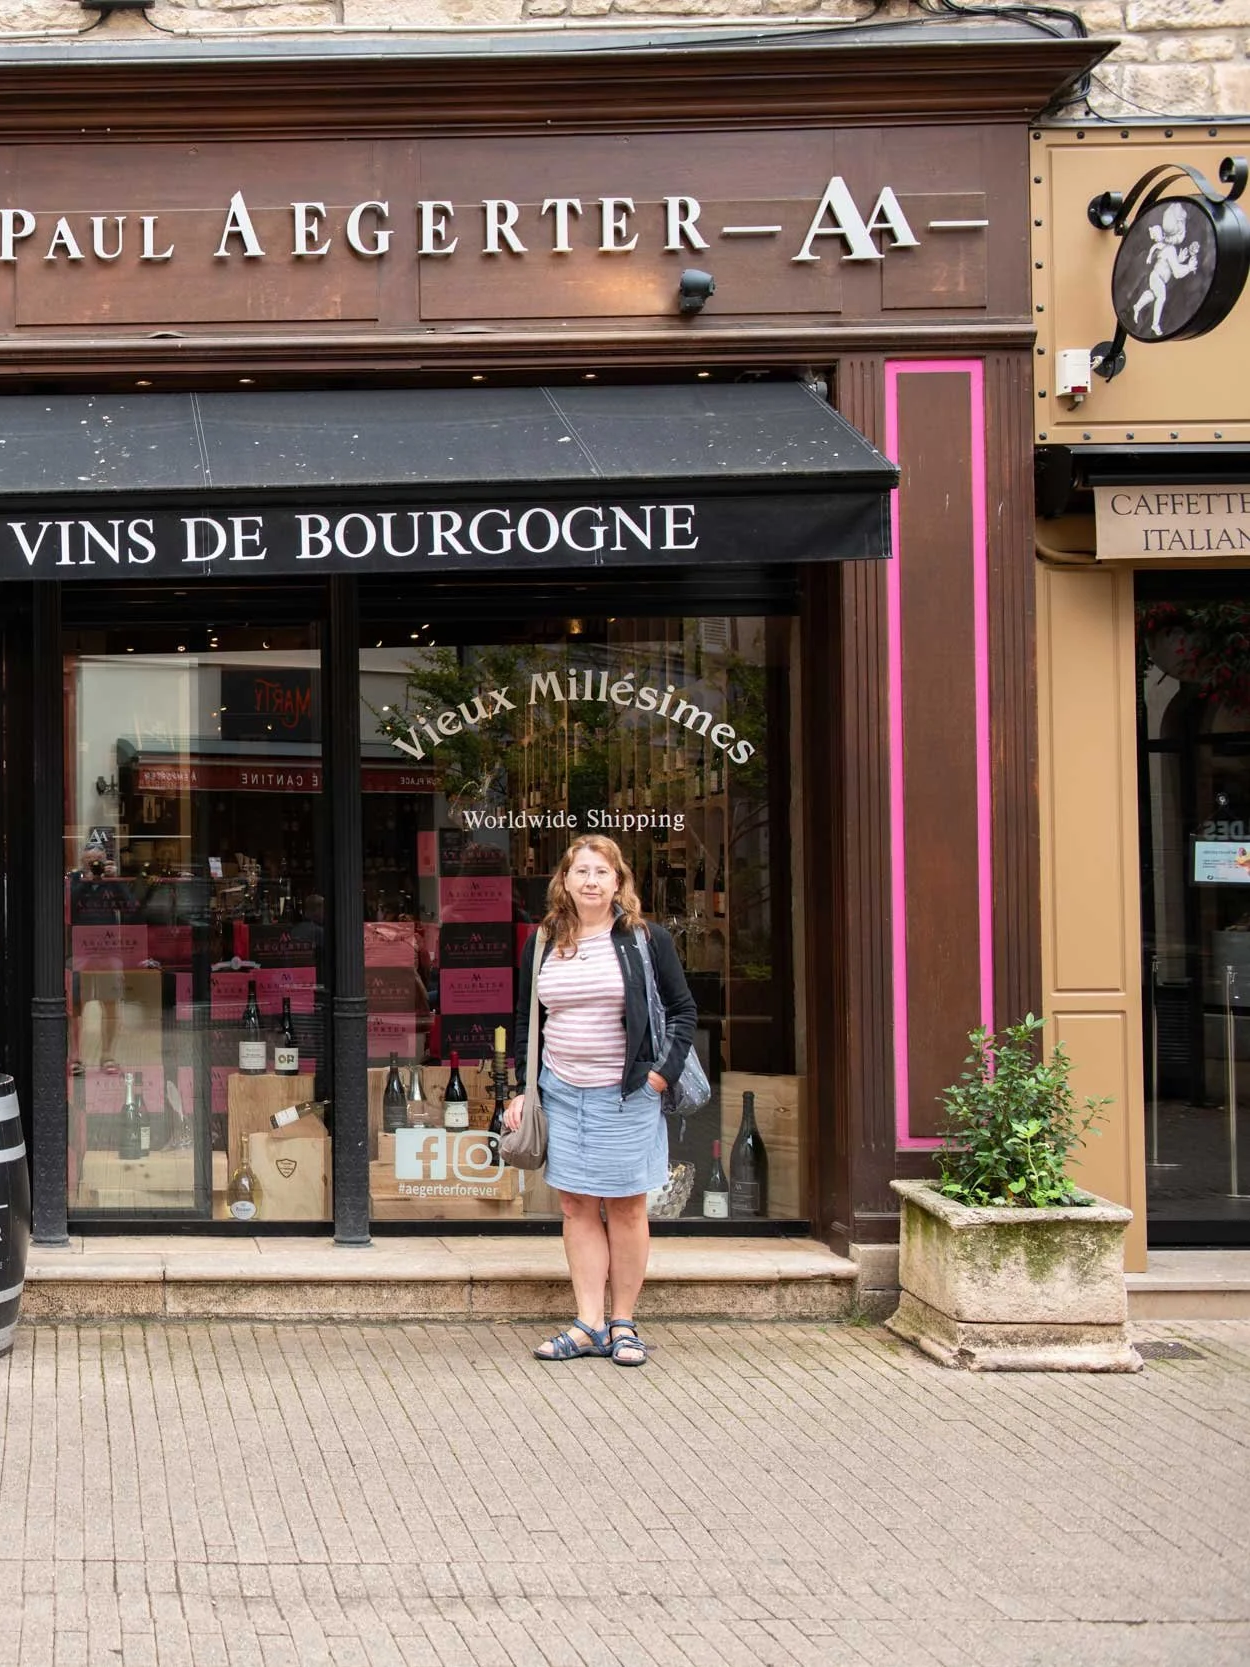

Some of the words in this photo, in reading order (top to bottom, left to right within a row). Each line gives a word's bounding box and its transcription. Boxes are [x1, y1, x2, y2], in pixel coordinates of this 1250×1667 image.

[214, 190, 711, 257] AEGERTER
[792, 176, 921, 261] AA
[7, 519, 156, 566] VINS
[181, 517, 267, 562] DE
[295, 505, 699, 559] BOURGOGNE
[391, 686, 517, 762] Vieux
[528, 667, 756, 765] Millésimes
[463, 808, 578, 832] Worldwide
[586, 807, 686, 832] Shipping
[398, 1183, 500, 1198] #aegerterforever
